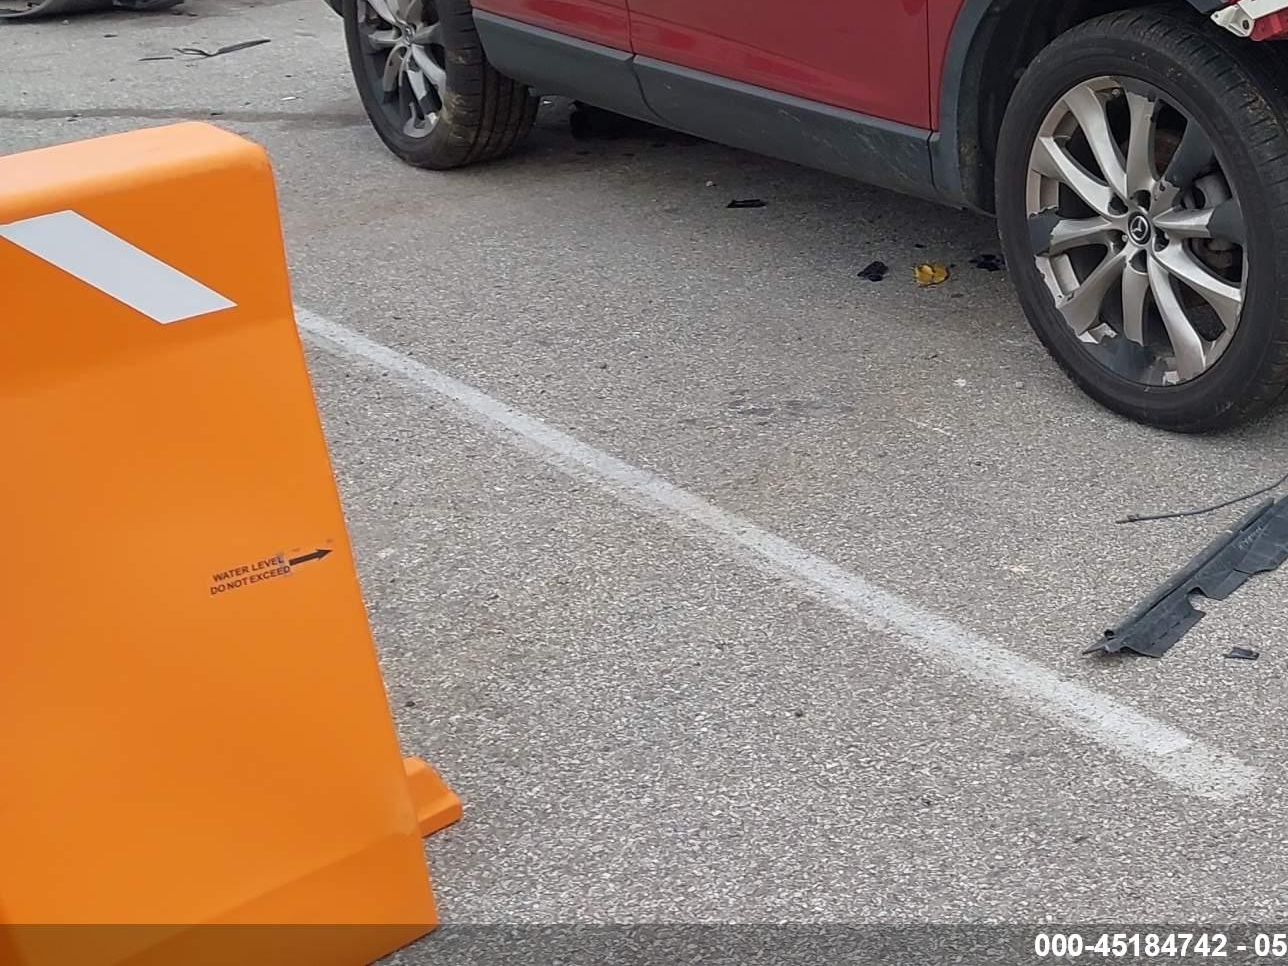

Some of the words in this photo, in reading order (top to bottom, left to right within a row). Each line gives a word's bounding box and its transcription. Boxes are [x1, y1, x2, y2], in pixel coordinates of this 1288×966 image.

[210, 585, 226, 595] DO
[226, 577, 248, 590] NOT
[249, 565, 291, 584] EXCEED
[212, 565, 249, 583] WATER
[251, 555, 285, 572] LEVEL
